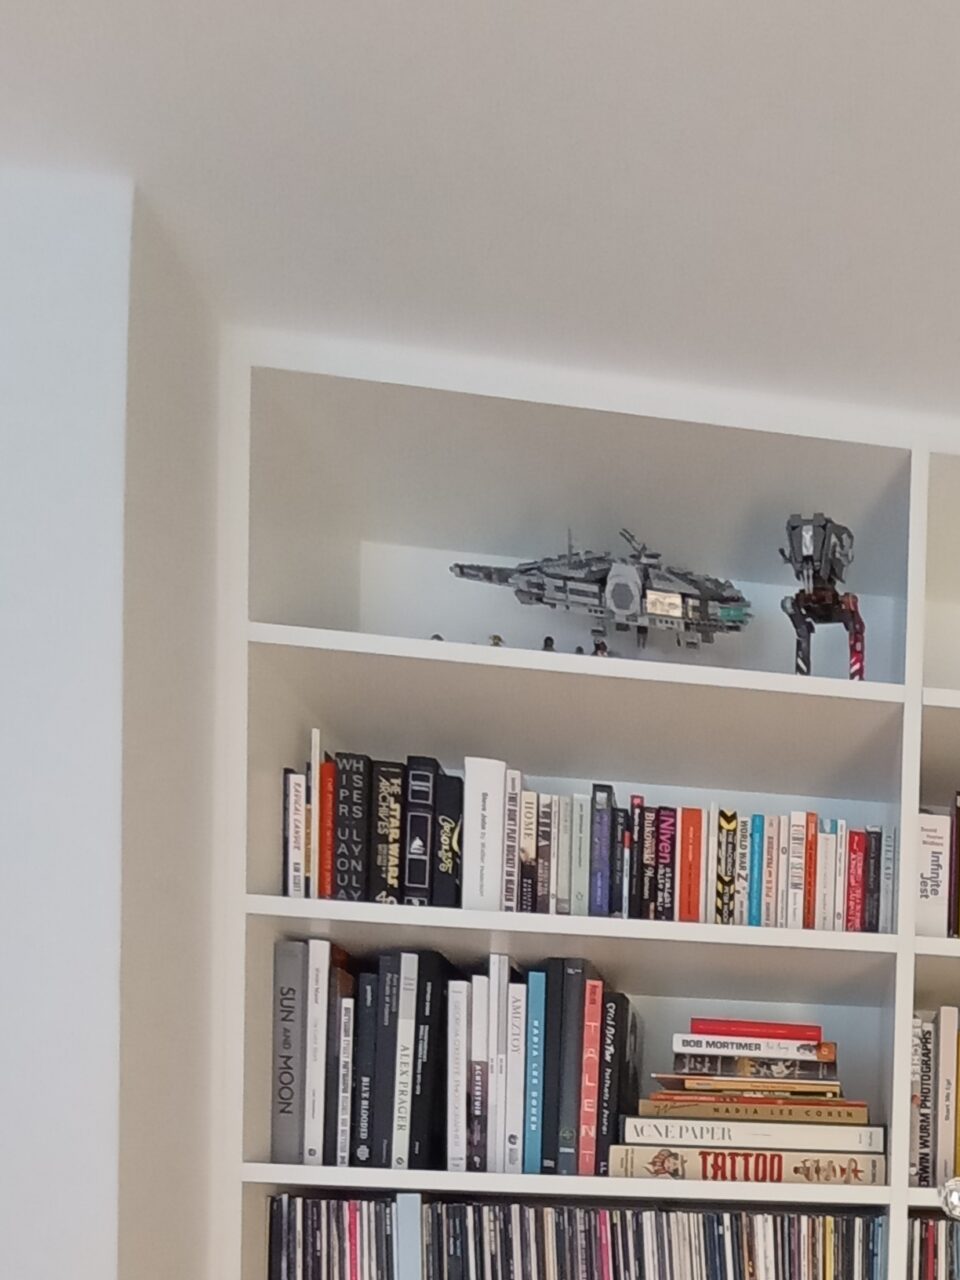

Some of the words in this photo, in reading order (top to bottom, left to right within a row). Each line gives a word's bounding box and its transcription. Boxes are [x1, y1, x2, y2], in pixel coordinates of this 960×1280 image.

[389, 777, 401, 795] THE
[507, 792, 519, 808] THEY
[377, 776, 391, 836] ARCHIVES
[387, 797, 401, 844] STAR
[506, 808, 518, 828] DON'T
[523, 801, 536, 841] HOME
[506, 828, 518, 845] PLAY
[538, 807, 551, 848] LILA
[643, 810, 656, 865] Bukowski
[659, 816, 675, 864] Niven
[739, 820, 750, 850] WORLD
[387, 844, 400, 889] WARS
[736, 872, 749, 884] Z
[738, 851, 749, 871] WAR
[930, 851, 944, 897] Infinite
[919, 872, 932, 900] Jest
[279, 987, 297, 1023] SUN
[281, 1027, 291, 1050] AND
[510, 995, 523, 1055] AMEZTOY
[399, 1044, 411, 1077] ALEX
[682, 1039, 703, 1048] BOB
[705, 1041, 762, 1052] MORTIMER
[277, 1054, 297, 1115] MOON
[920, 1030, 932, 1111] PHOTOGRAPHS
[359, 1099, 370, 1140] BLOODED
[396, 1081, 410, 1132] PRAGER
[713, 1106, 760, 1116] NADIA
[769, 1108, 794, 1117] LEE
[804, 1109, 854, 1119] COHEN
[633, 1124, 677, 1140] ACNE
[678, 1125, 733, 1141] PAPER
[918, 1112, 931, 1150] WURM
[699, 1151, 783, 1183] TATTOO
[918, 1153, 931, 1188] ERWIN
